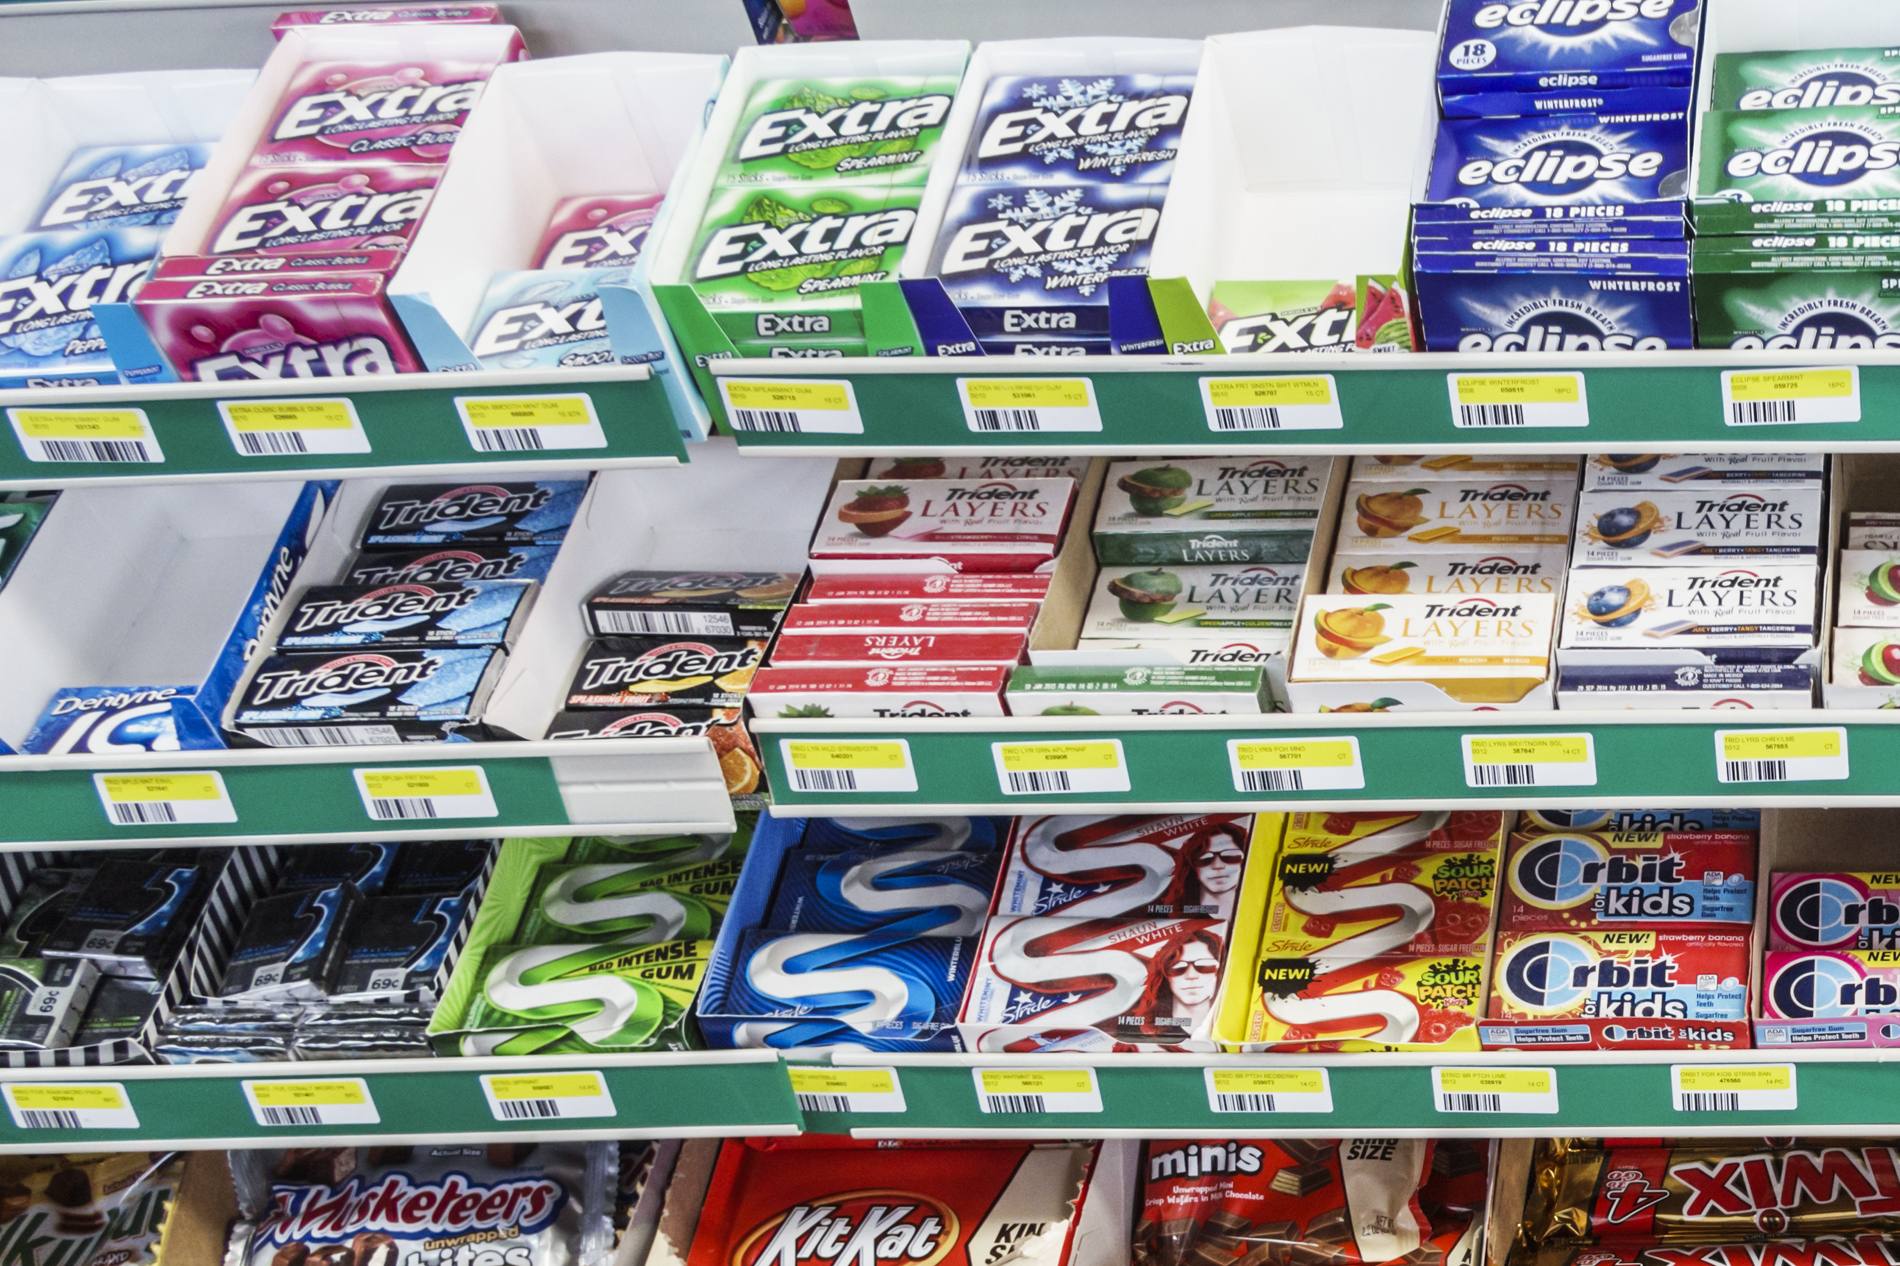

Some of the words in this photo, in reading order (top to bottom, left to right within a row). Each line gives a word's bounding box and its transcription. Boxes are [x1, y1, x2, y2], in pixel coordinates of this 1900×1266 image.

[320, 6, 390, 23] Extra
[1538, 72, 1598, 89] eclipse
[738, 94, 951, 161] Extra
[978, 94, 1190, 160] Extra
[1598, 111, 1685, 124] WINTERFROST
[1028, 136, 1058, 152] LONG
[1061, 130, 1108, 146] LASTING
[1112, 127, 1159, 141] FLAVOR
[836, 150, 922, 174] SPEARMINT
[1078, 149, 1176, 171] WINTERFRESH
[1456, 148, 1665, 189] eclipse
[1469, 204, 1534, 220] eclipse
[1548, 206, 1571, 219] 18
[1574, 204, 1625, 219] PIECES
[1750, 199, 1814, 215] eclipse
[1825, 199, 1846, 212] 18
[205, 254, 286, 276] Extra
[289, 258, 329, 270] CLASSIC
[331, 255, 370, 266] BUBBLE
[1589, 279, 1682, 294] WINTERFROST
[757, 313, 830, 336] Extra
[1002, 309, 1076, 332] Extra
[1457, 378, 1488, 386] ECLIPSE
[1489, 378, 1541, 386] WINTERFROST
[1731, 375, 1761, 383] ECLIPSE
[1762, 374, 1804, 382] SPEARMINT
[1189, 535, 1239, 550] Trident
[1181, 547, 1251, 563] LAYERS
[1686, 572, 1782, 592] Trident
[1666, 588, 1798, 608] LAYERS
[1688, 608, 1710, 618] With
[1713, 605, 1737, 619] Real
[1739, 608, 1764, 618] Fruit
[1766, 607, 1797, 618] Flavor
[585, 646, 761, 690] Trident
[256, 656, 438, 705] Trident
[50, 686, 178, 718] Dentyne
[569, 694, 621, 708] SPLASHING
[622, 692, 655, 705] FRUIT
[1108, 922, 1159, 944] SHAUN
[1135, 923, 1184, 944] WHITE
[1601, 932, 1652, 945] NEW!
[1659, 934, 1707, 944] strawberry
[1709, 935, 1745, 943] banana
[588, 960, 615, 973] MAD
[618, 941, 698, 970] INTENSE
[640, 963, 697, 983] GUM
[1264, 967, 1311, 982] NEW!
[1421, 968, 1479, 986] SOUR
[1418, 982, 1481, 1003] PATCH
[1001, 996, 1056, 1025] Stride
[1516, 1035, 1535, 1043] Helps
[1537, 1035, 1564, 1043] Protect
[1566, 1034, 1586, 1042] Teeth
[1604, 1024, 1675, 1043] Orbit
[1688, 1025, 1734, 1043] kids
[1150, 1143, 1264, 1182] minis
[295, 1176, 561, 1241] Musketeers
